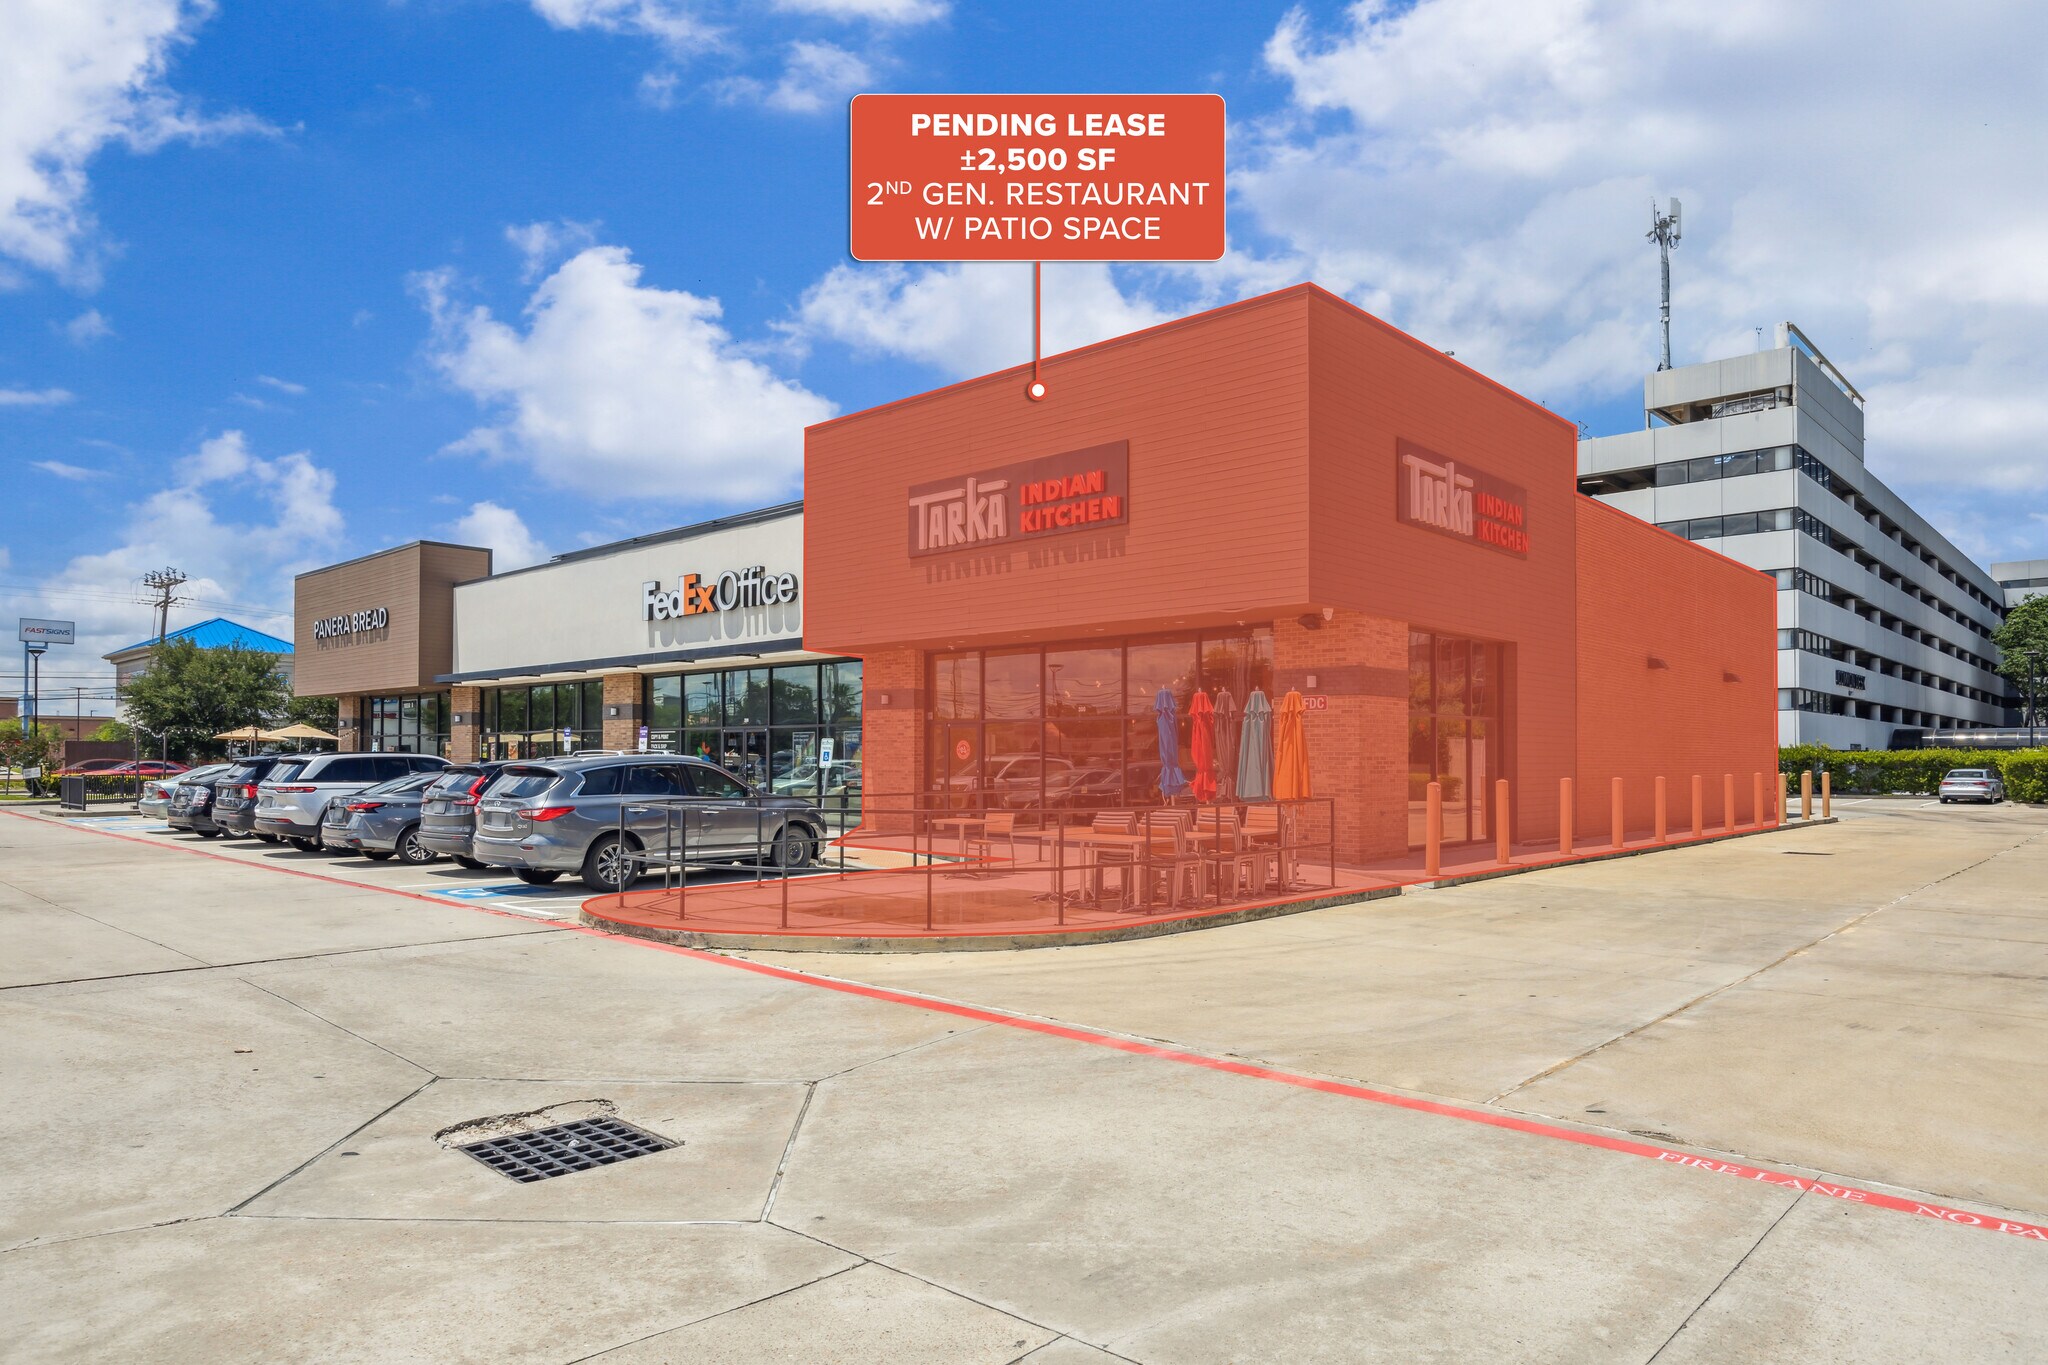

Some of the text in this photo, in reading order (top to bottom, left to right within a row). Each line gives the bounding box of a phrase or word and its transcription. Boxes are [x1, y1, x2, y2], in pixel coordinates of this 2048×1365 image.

[1020, 469, 1104, 506] INDIAN
[1020, 495, 1121, 533] KITCHEN
[1478, 492, 1523, 526] INDIAN
[1478, 519, 1530, 553] KITCHEN
[642, 565, 799, 621] FedEx Office
[25, 626, 71, 636] FASTSIGNS
[313, 607, 388, 639] PANERA BREAD
[1657, 1151, 1742, 1176] FIRE
[1753, 1171, 1867, 1203] LANE
[1914, 1204, 1983, 1226] NO
